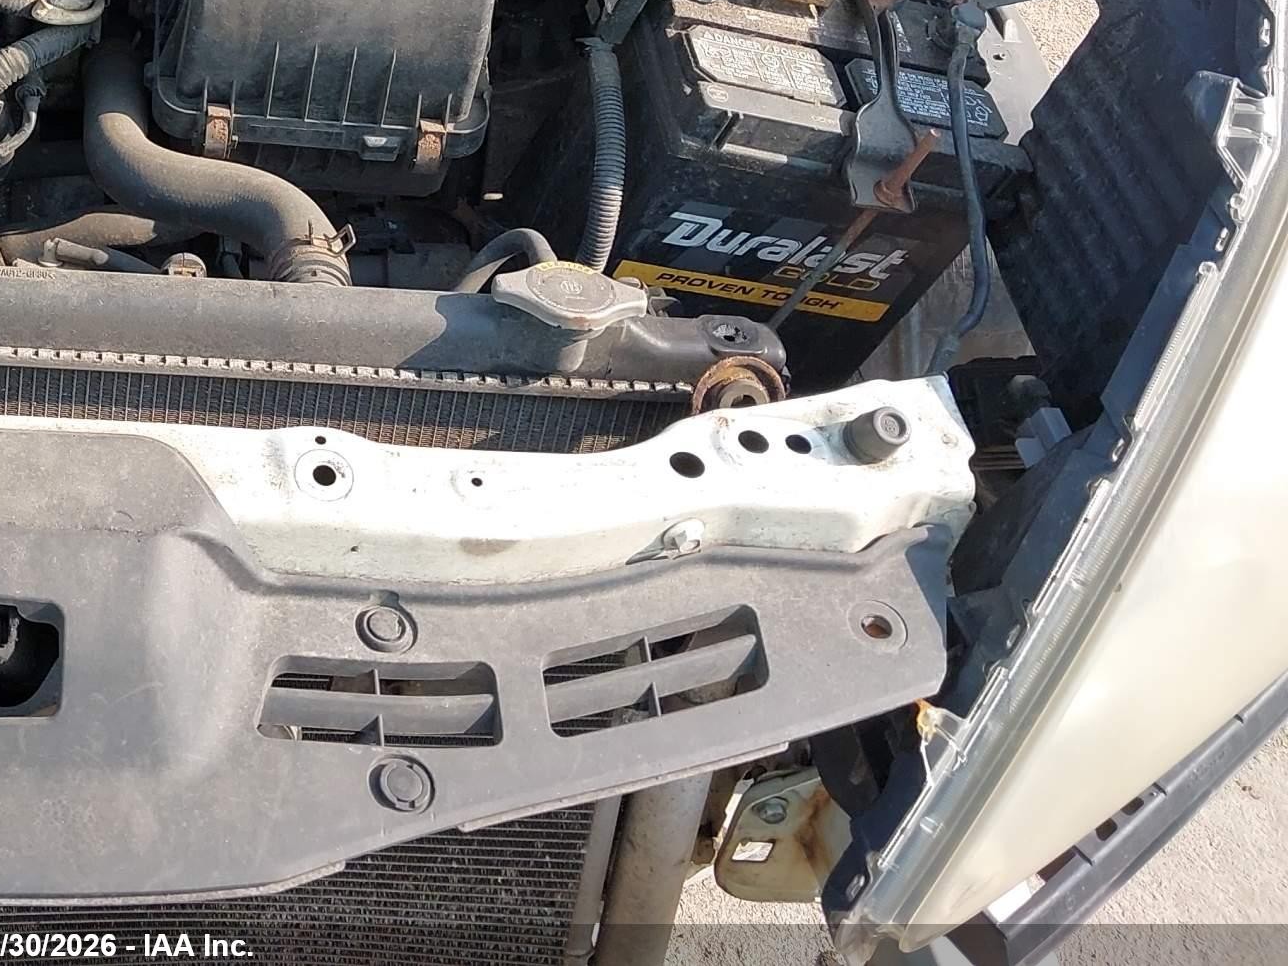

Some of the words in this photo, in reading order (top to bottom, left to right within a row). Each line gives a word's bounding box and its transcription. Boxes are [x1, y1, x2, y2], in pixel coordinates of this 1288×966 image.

[716, 34, 762, 50] DANGER
[774, 45, 816, 61] POISON
[662, 211, 908, 280] Duralast
[655, 272, 758, 296] PROVEN
[761, 289, 841, 310] TOGH
